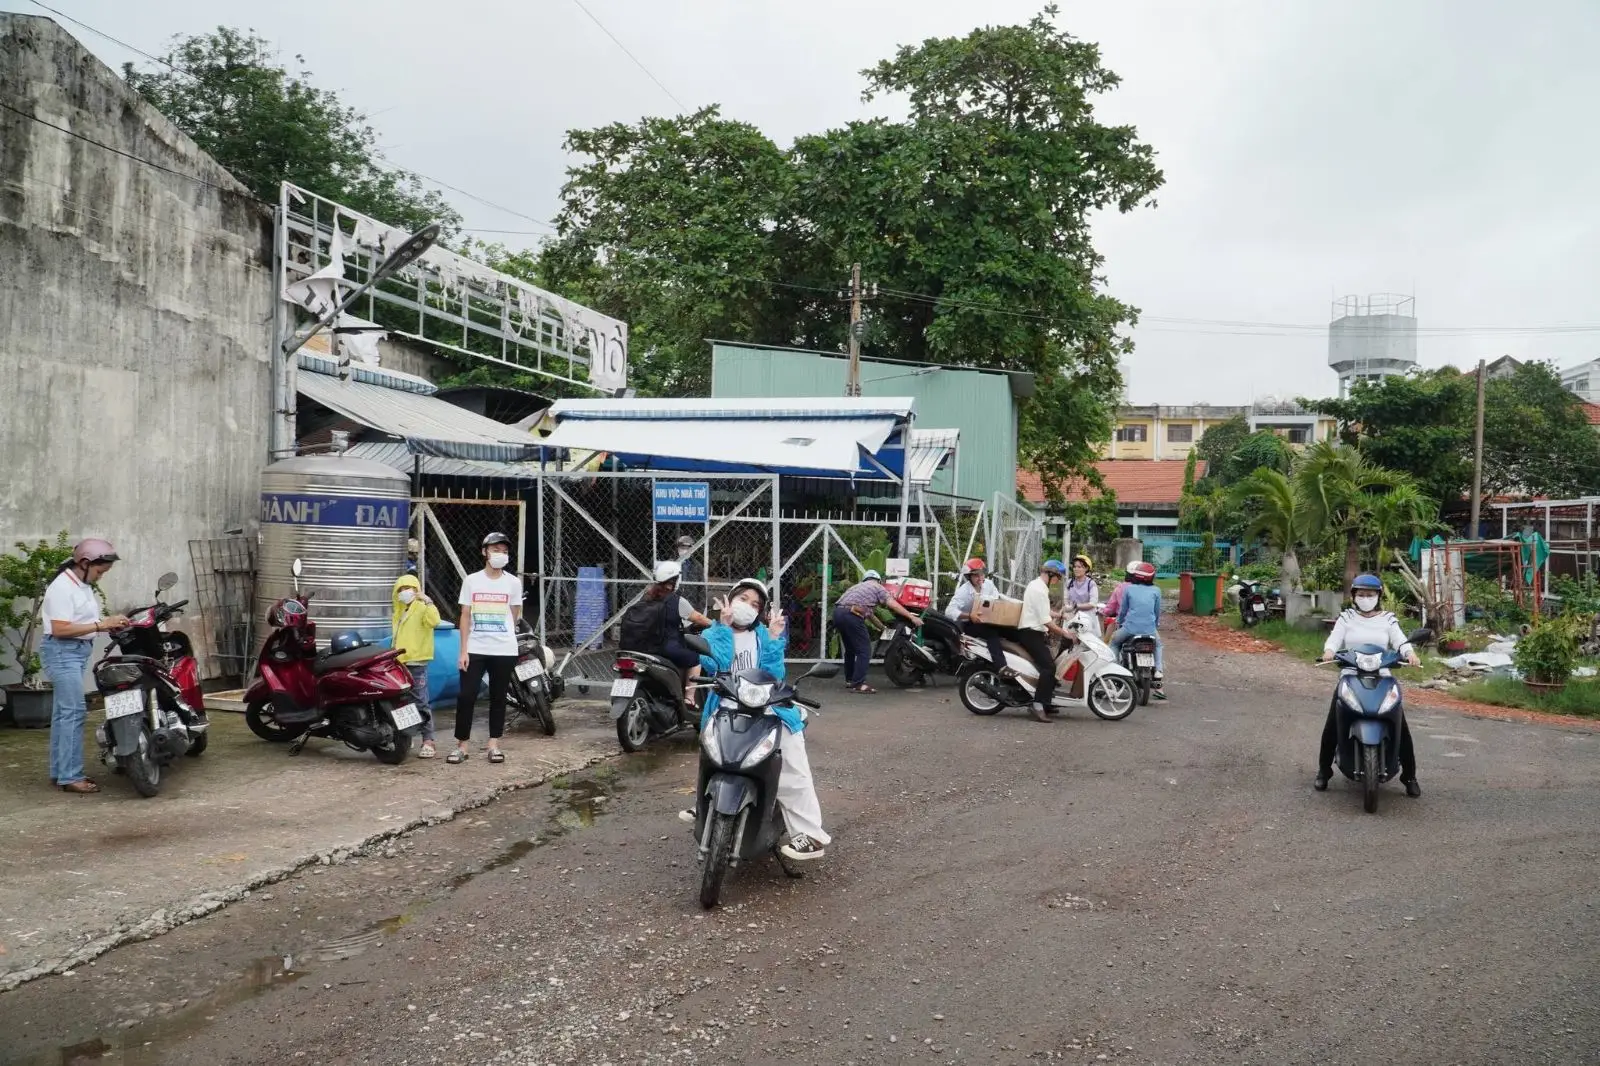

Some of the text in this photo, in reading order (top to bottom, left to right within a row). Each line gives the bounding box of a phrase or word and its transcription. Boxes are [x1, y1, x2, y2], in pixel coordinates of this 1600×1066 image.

[655, 488, 667, 498] KHU
[669, 487, 680, 499] VỰC
[681, 487, 692, 498] NHÀ
[656, 505, 667, 516] XIN
[697, 506, 705, 516] XE
